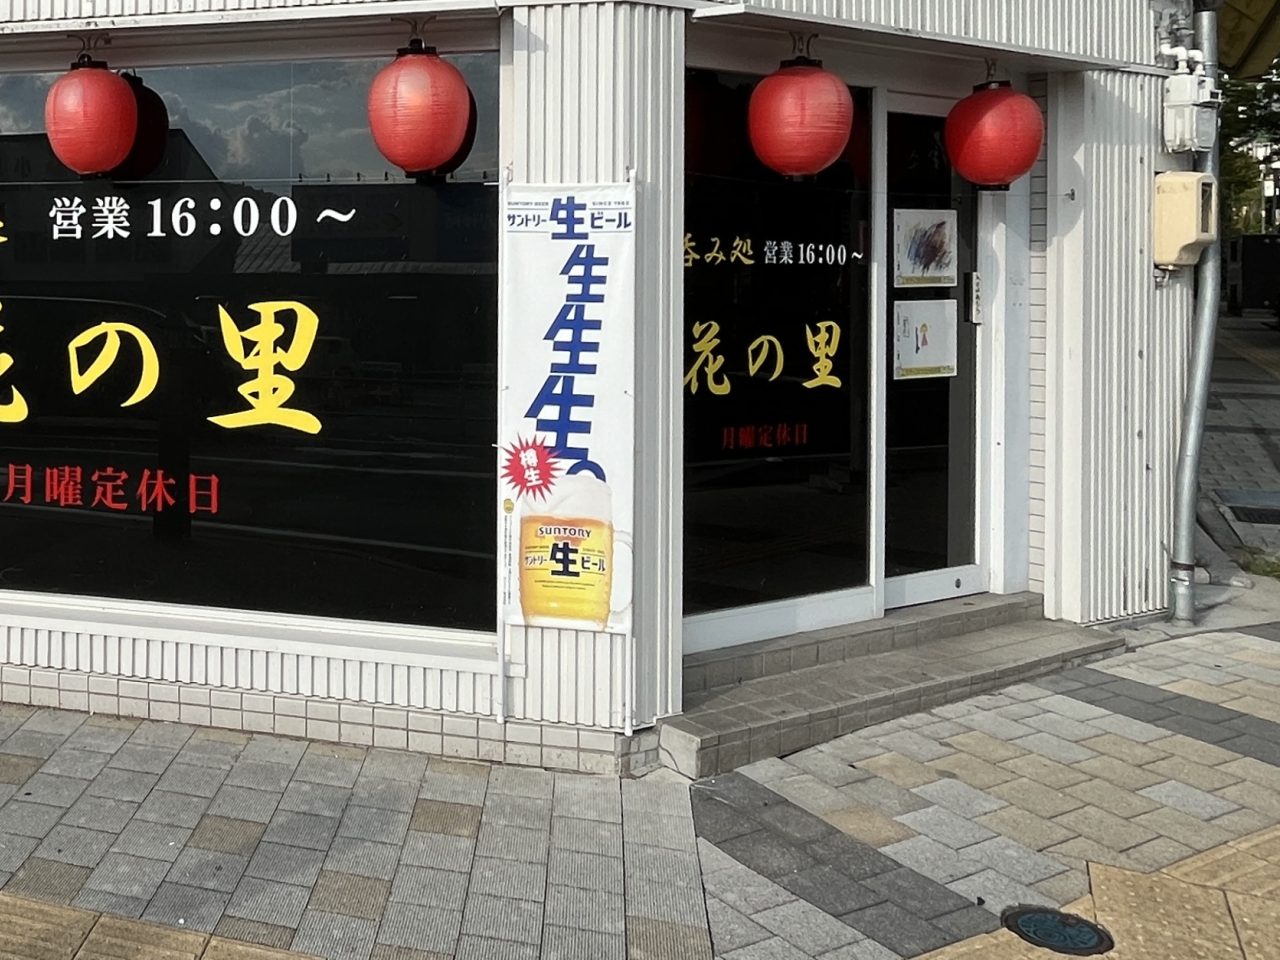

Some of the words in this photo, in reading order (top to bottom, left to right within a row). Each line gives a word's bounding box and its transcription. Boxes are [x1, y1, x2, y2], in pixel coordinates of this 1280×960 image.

[683, 320, 842, 395] 花の里
[722, 423, 809, 450] 月曜定休日
[2, 463, 221, 516] 月曜定休日
[538, 526, 592, 538] SUNTORY
